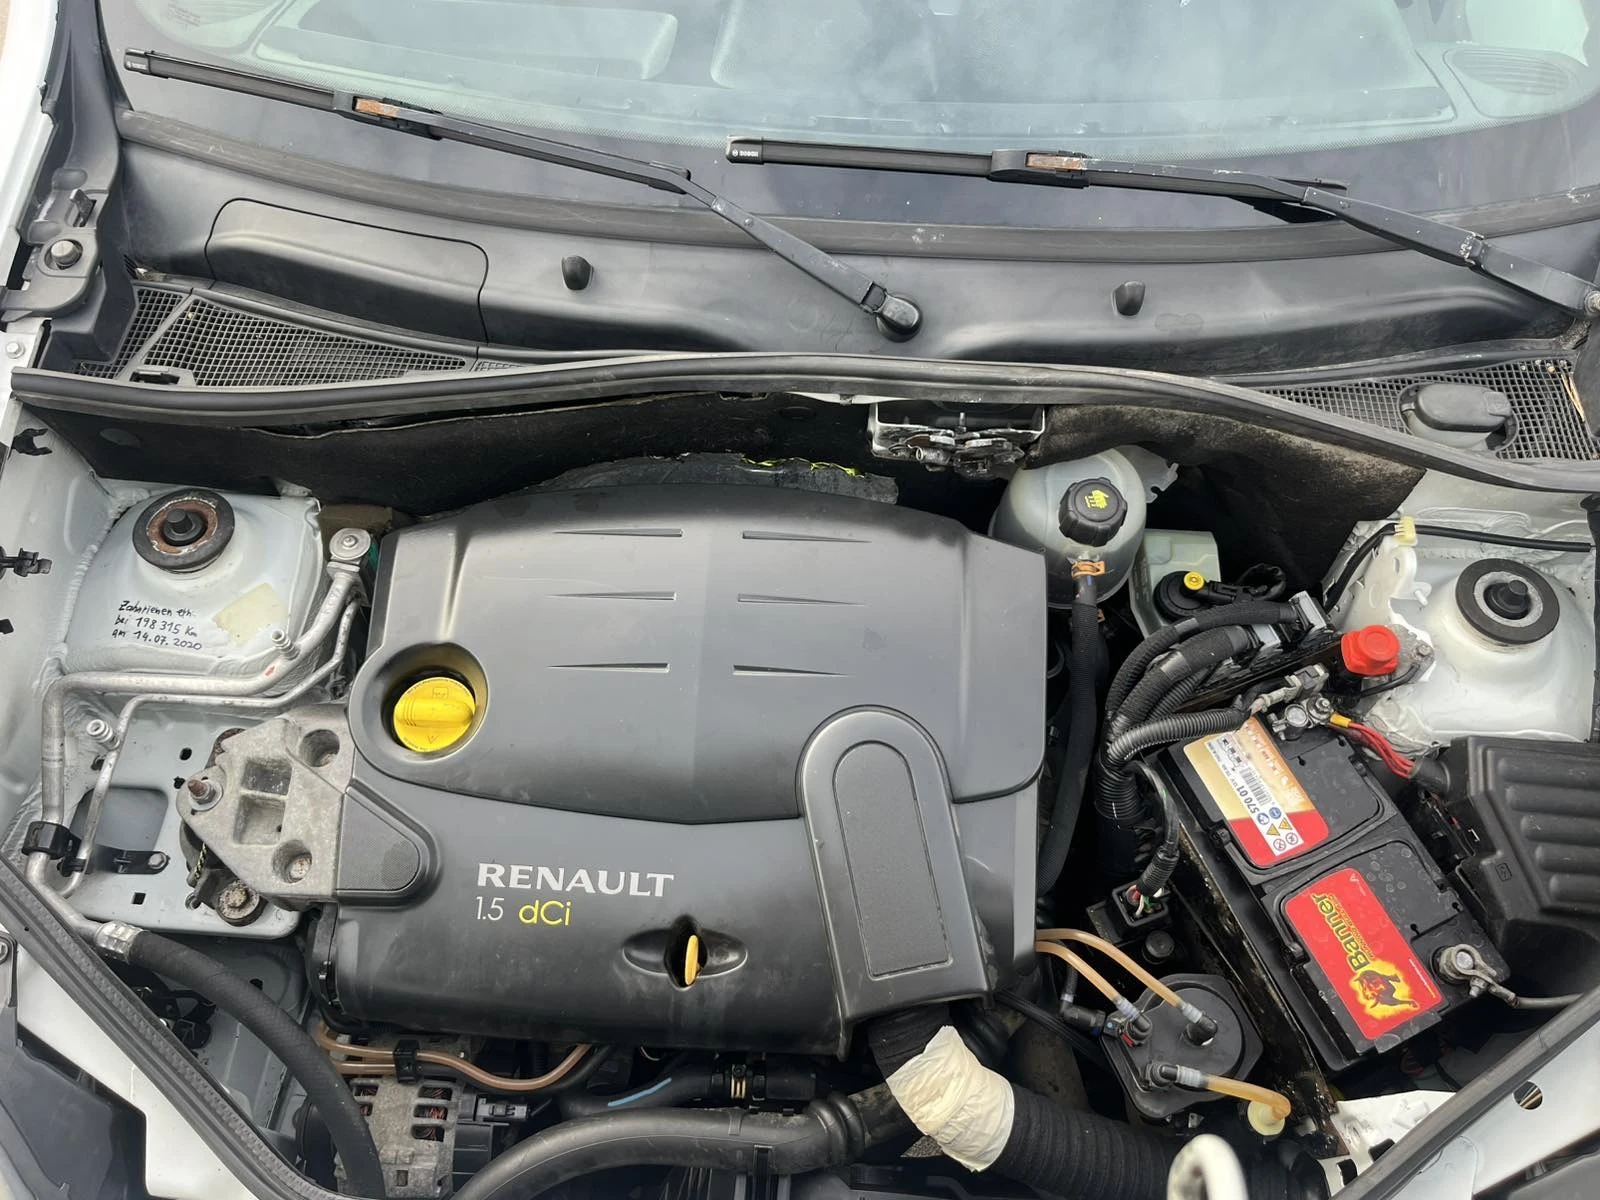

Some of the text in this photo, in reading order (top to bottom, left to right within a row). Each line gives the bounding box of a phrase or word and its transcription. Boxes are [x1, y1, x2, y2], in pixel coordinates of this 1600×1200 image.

[477, 863, 675, 897] RENAULT
[476, 896, 572, 926] 1.5 dCi
[1311, 892, 1371, 972] Banner
